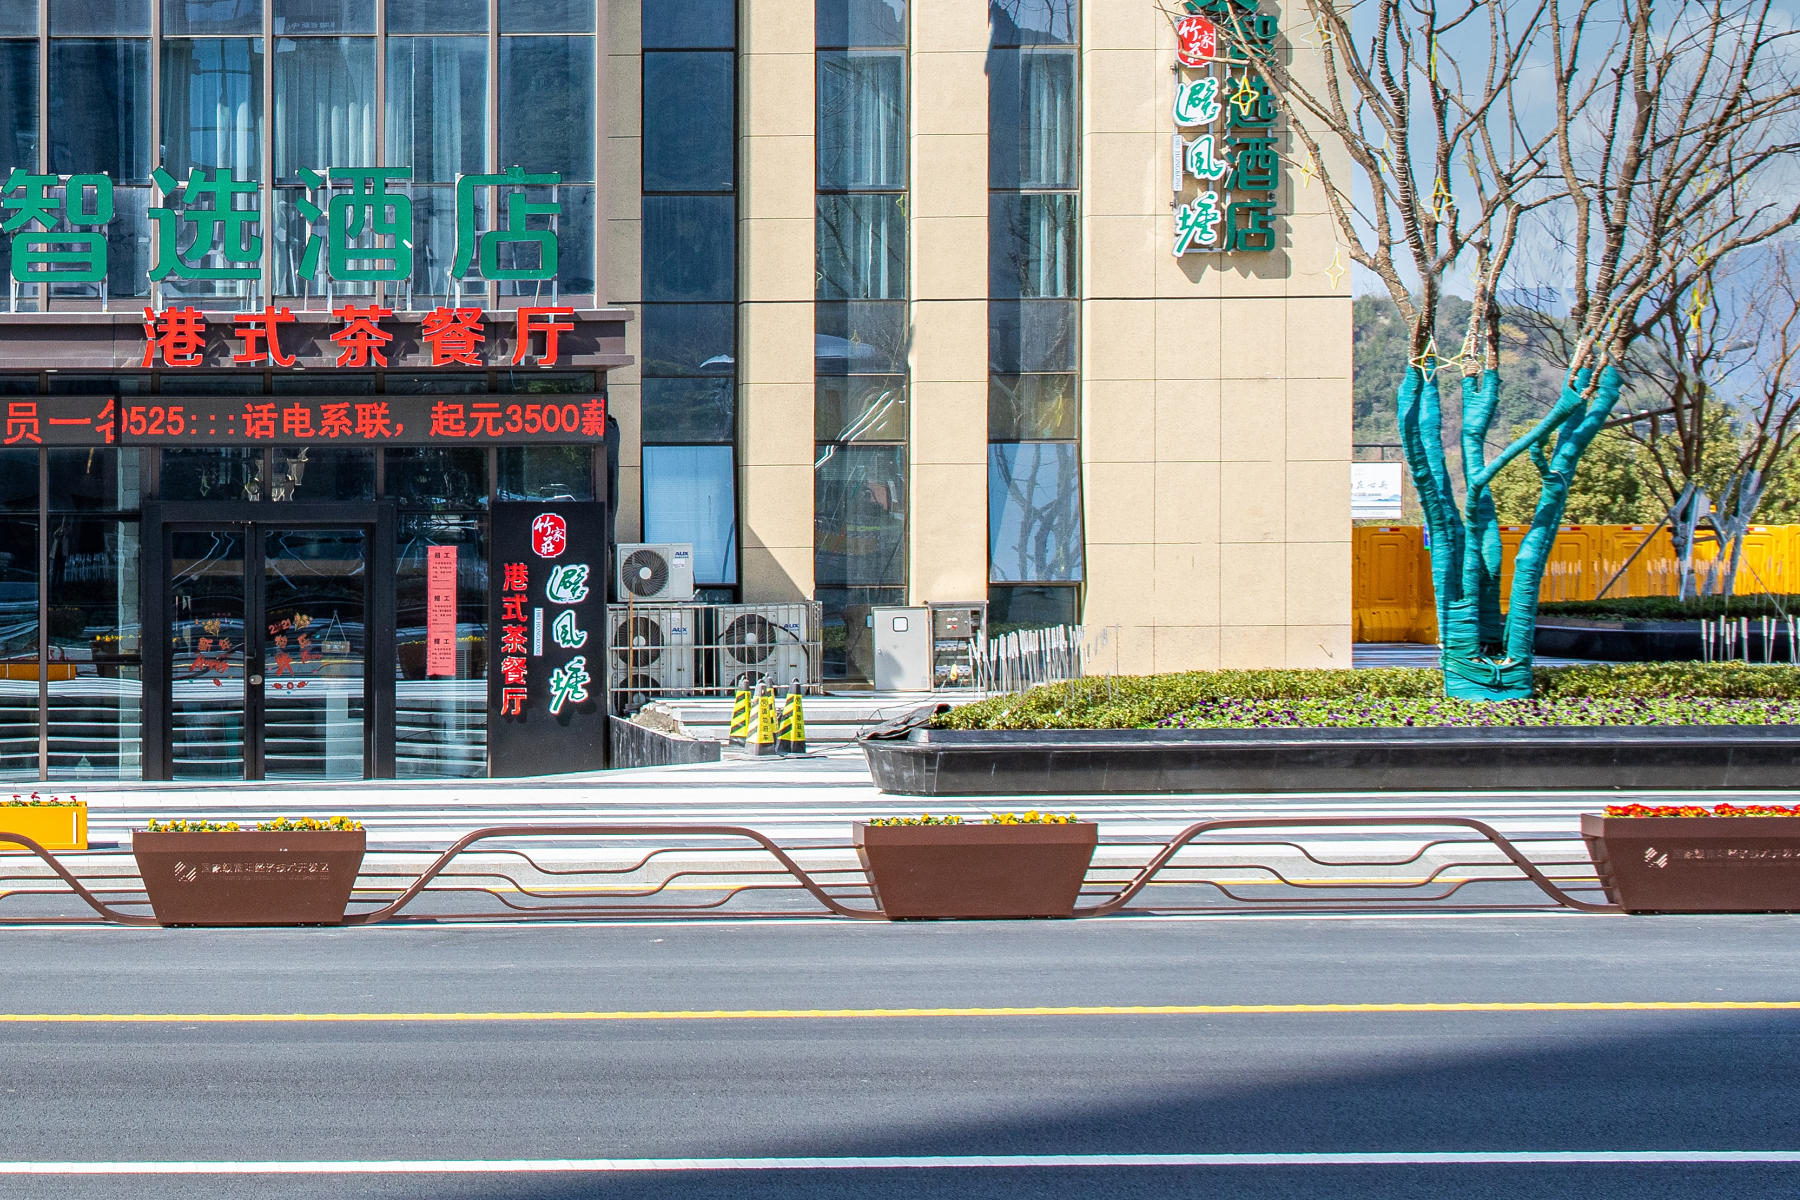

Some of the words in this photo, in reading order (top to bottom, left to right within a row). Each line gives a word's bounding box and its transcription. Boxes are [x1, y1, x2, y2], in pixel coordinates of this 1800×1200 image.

[142, 305, 575, 367] 港式茶餐厅
[501, 563, 529, 716] 港式茶餐厅
